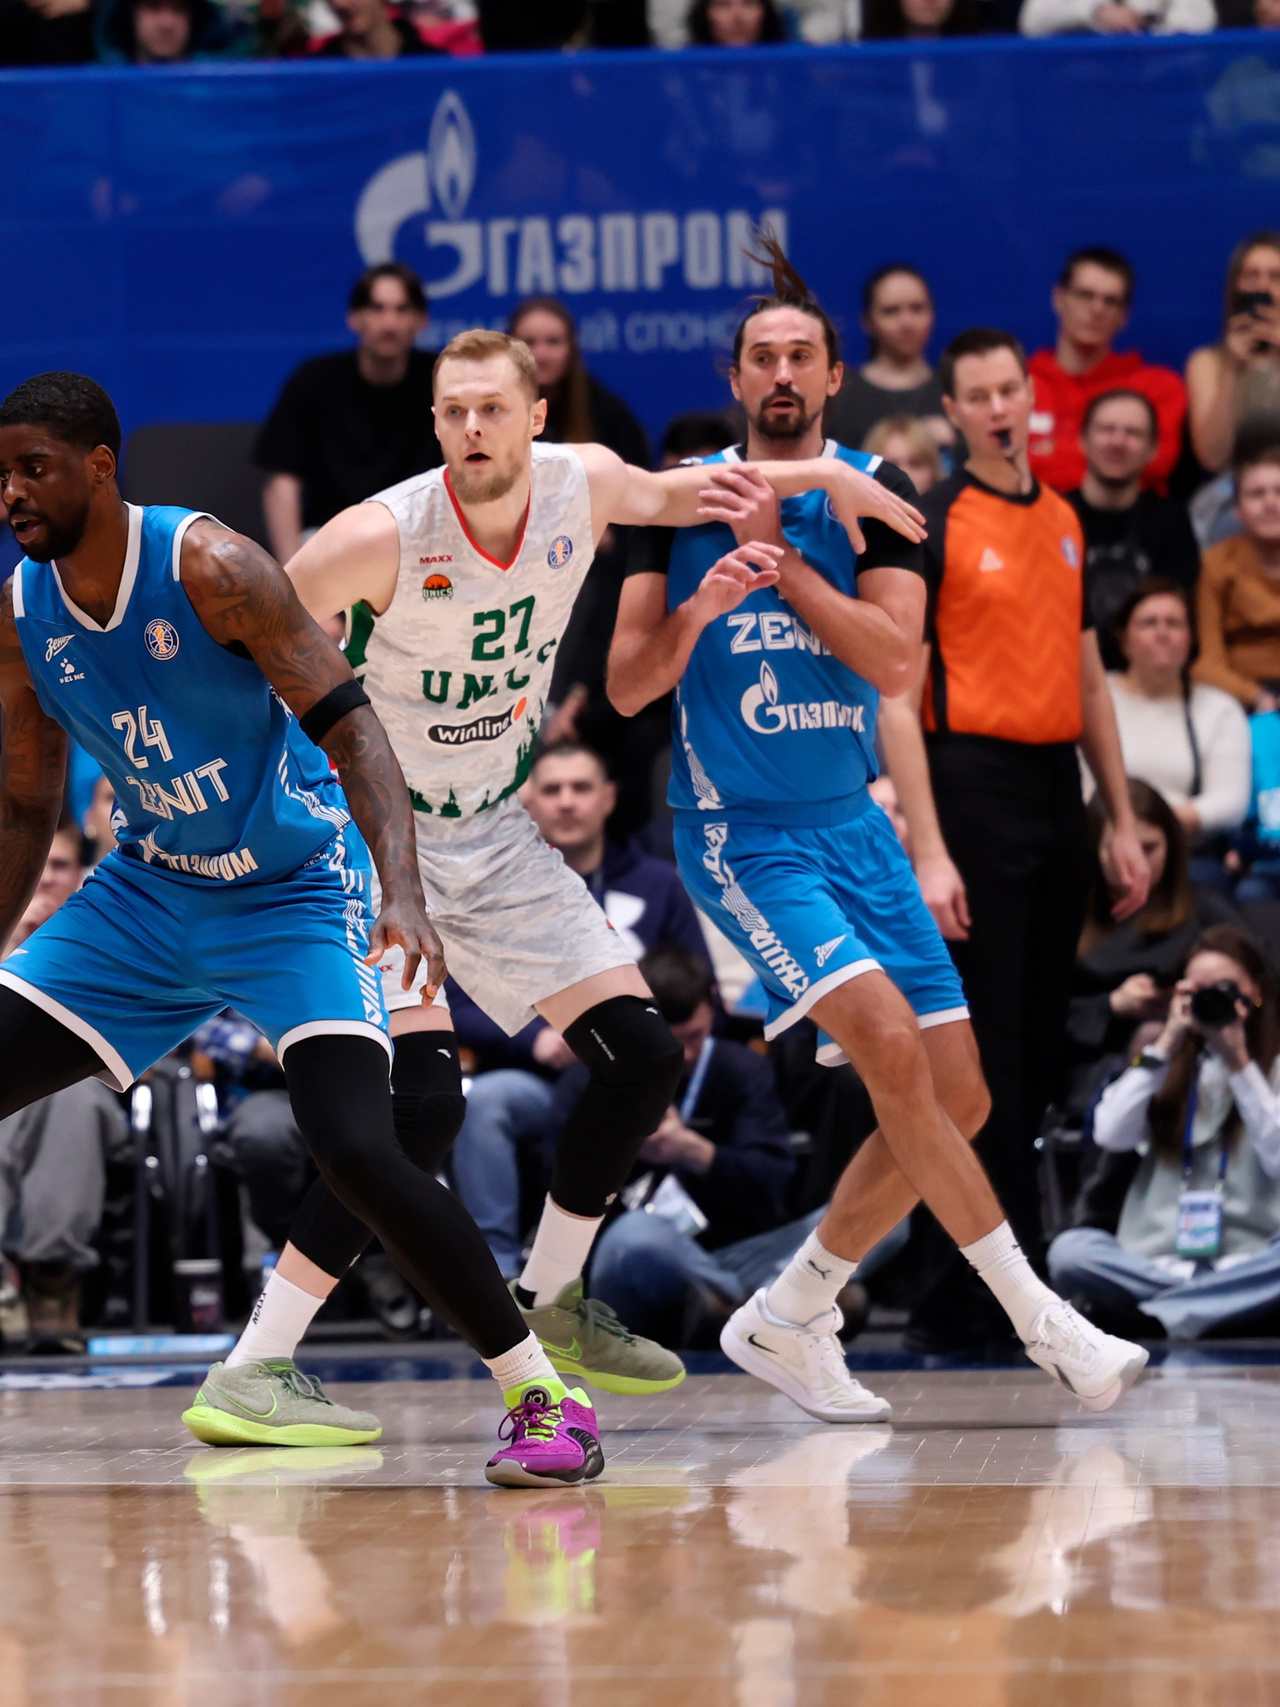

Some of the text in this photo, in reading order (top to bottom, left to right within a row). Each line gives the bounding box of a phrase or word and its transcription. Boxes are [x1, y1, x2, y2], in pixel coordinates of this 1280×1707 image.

[487, 208, 788, 296] ГАЗПРОМ
[419, 554, 453, 565] MAXX
[422, 586, 454, 601] UNICS
[471, 594, 536, 661] 27
[726, 611, 833, 656] ZEN
[111, 705, 174, 769] 24
[437, 716, 510, 743] Winline
